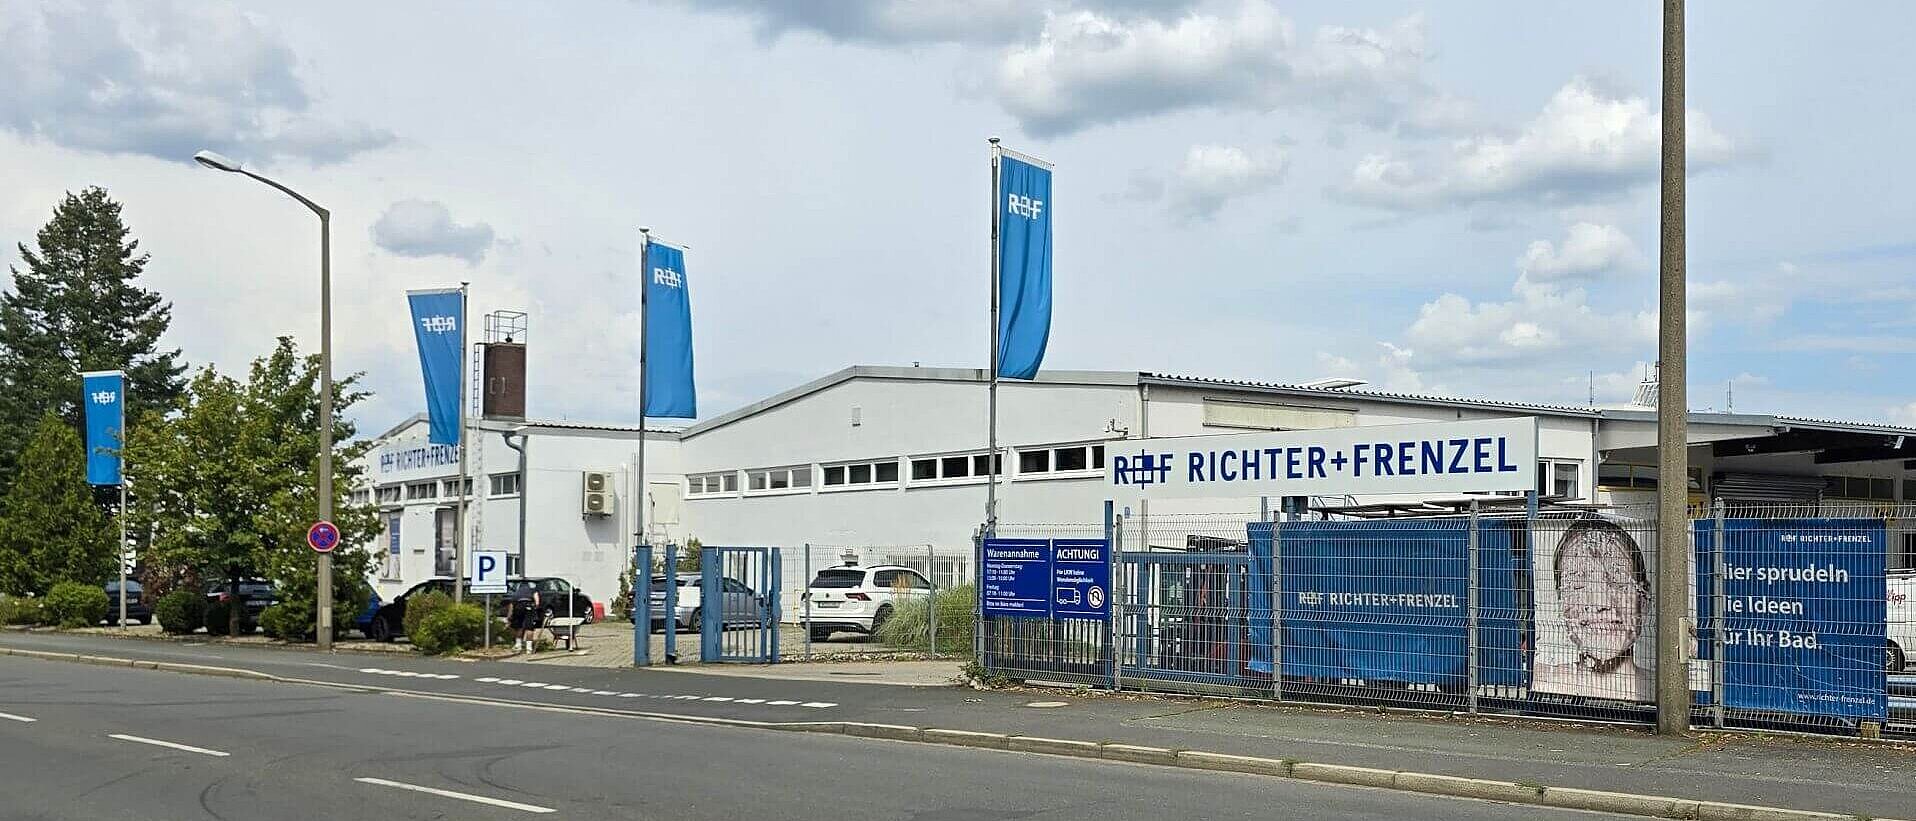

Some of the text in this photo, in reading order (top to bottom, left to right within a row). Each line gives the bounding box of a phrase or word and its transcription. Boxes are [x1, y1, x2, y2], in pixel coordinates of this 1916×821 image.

[396, 443, 460, 471] RICHTER+FRENZE
[1188, 437, 1517, 482] RICHTER+FRENZEL
[987, 549, 1039, 559] Warenannahme
[479, 556, 495, 581] P
[1757, 564, 1849, 585] sprudeln
[1330, 591, 1459, 608] RICHTER+FRENZEL
[1748, 596, 1803, 615] Ideen
[1747, 628, 1773, 647] Ihr
[1779, 631, 1823, 650] Bad.
